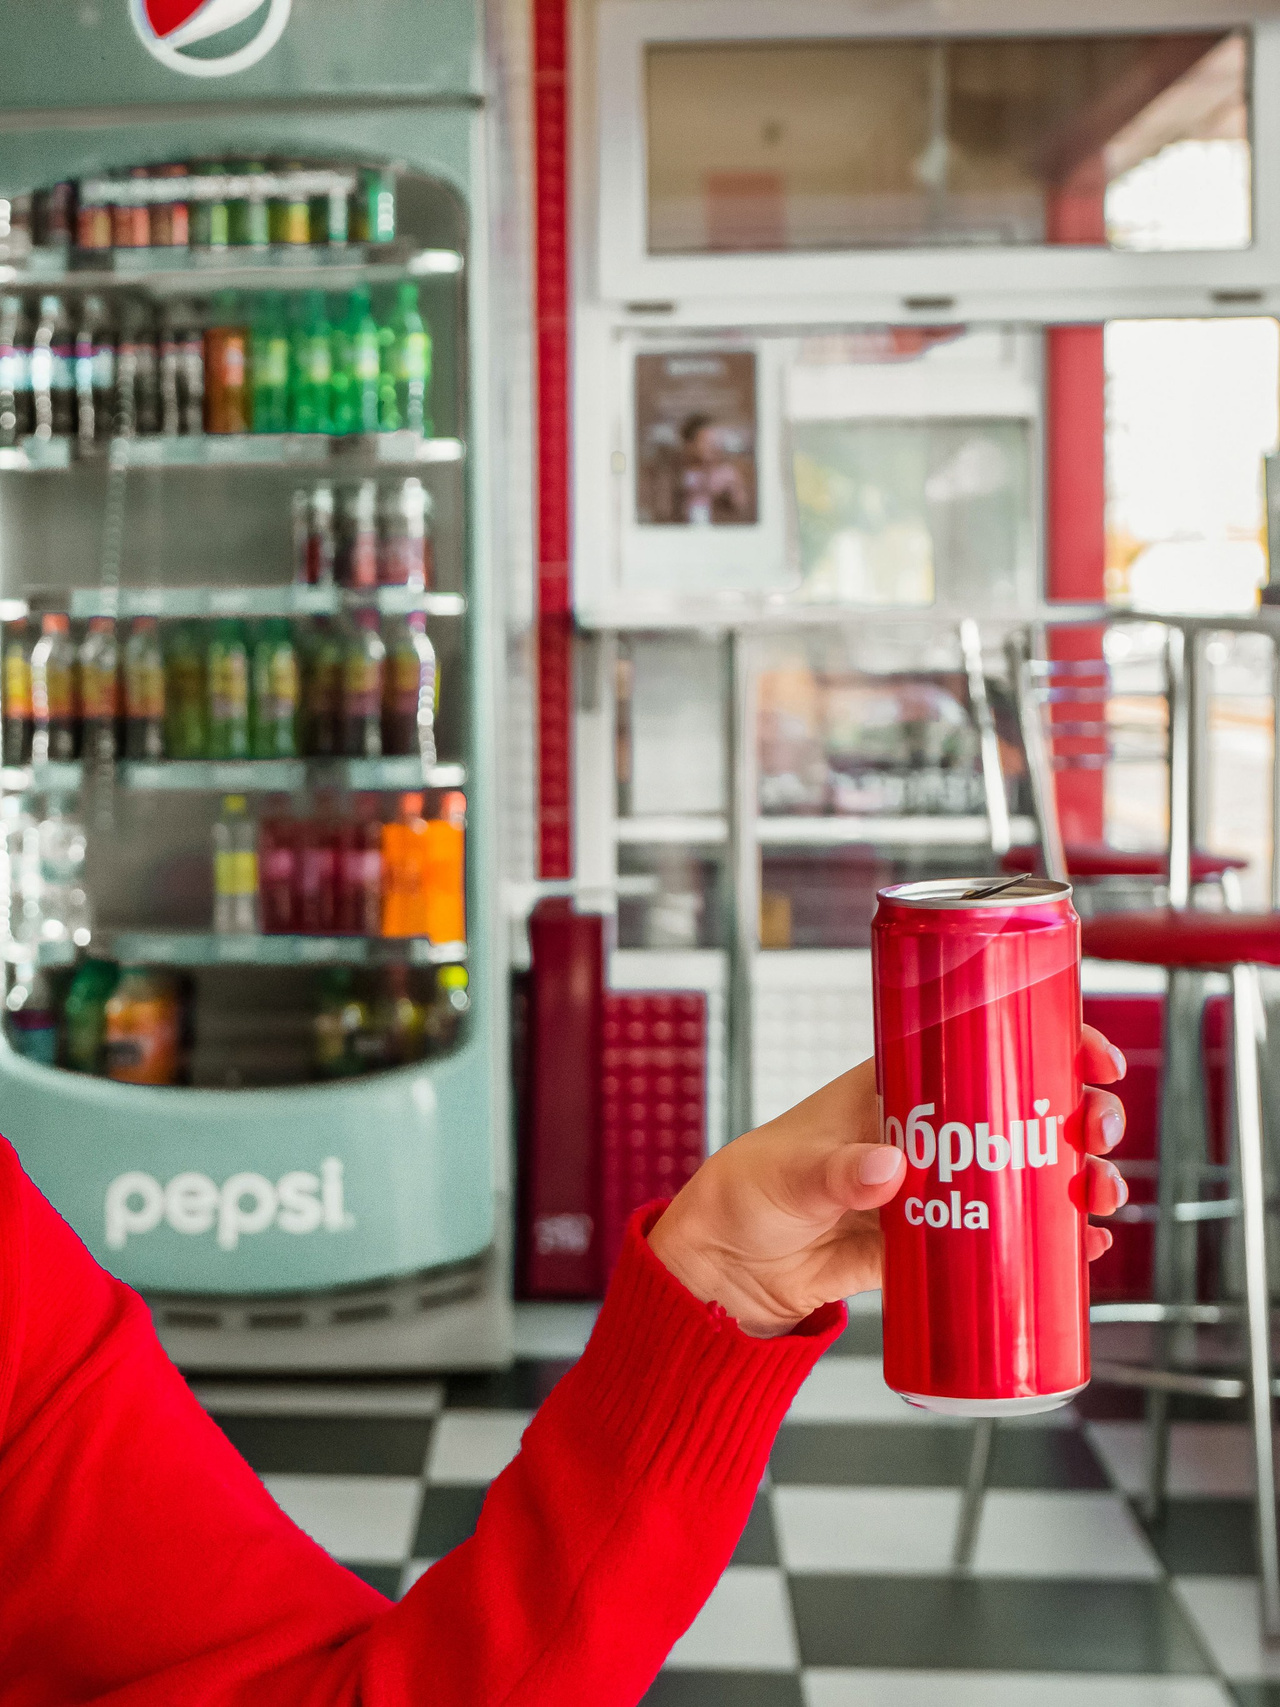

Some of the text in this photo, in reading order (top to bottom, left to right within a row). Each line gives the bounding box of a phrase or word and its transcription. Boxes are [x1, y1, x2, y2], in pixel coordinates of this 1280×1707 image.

[877, 1094, 1059, 1183] обрый
[104, 1157, 345, 1250] pepsi
[904, 1190, 990, 1230] cola
